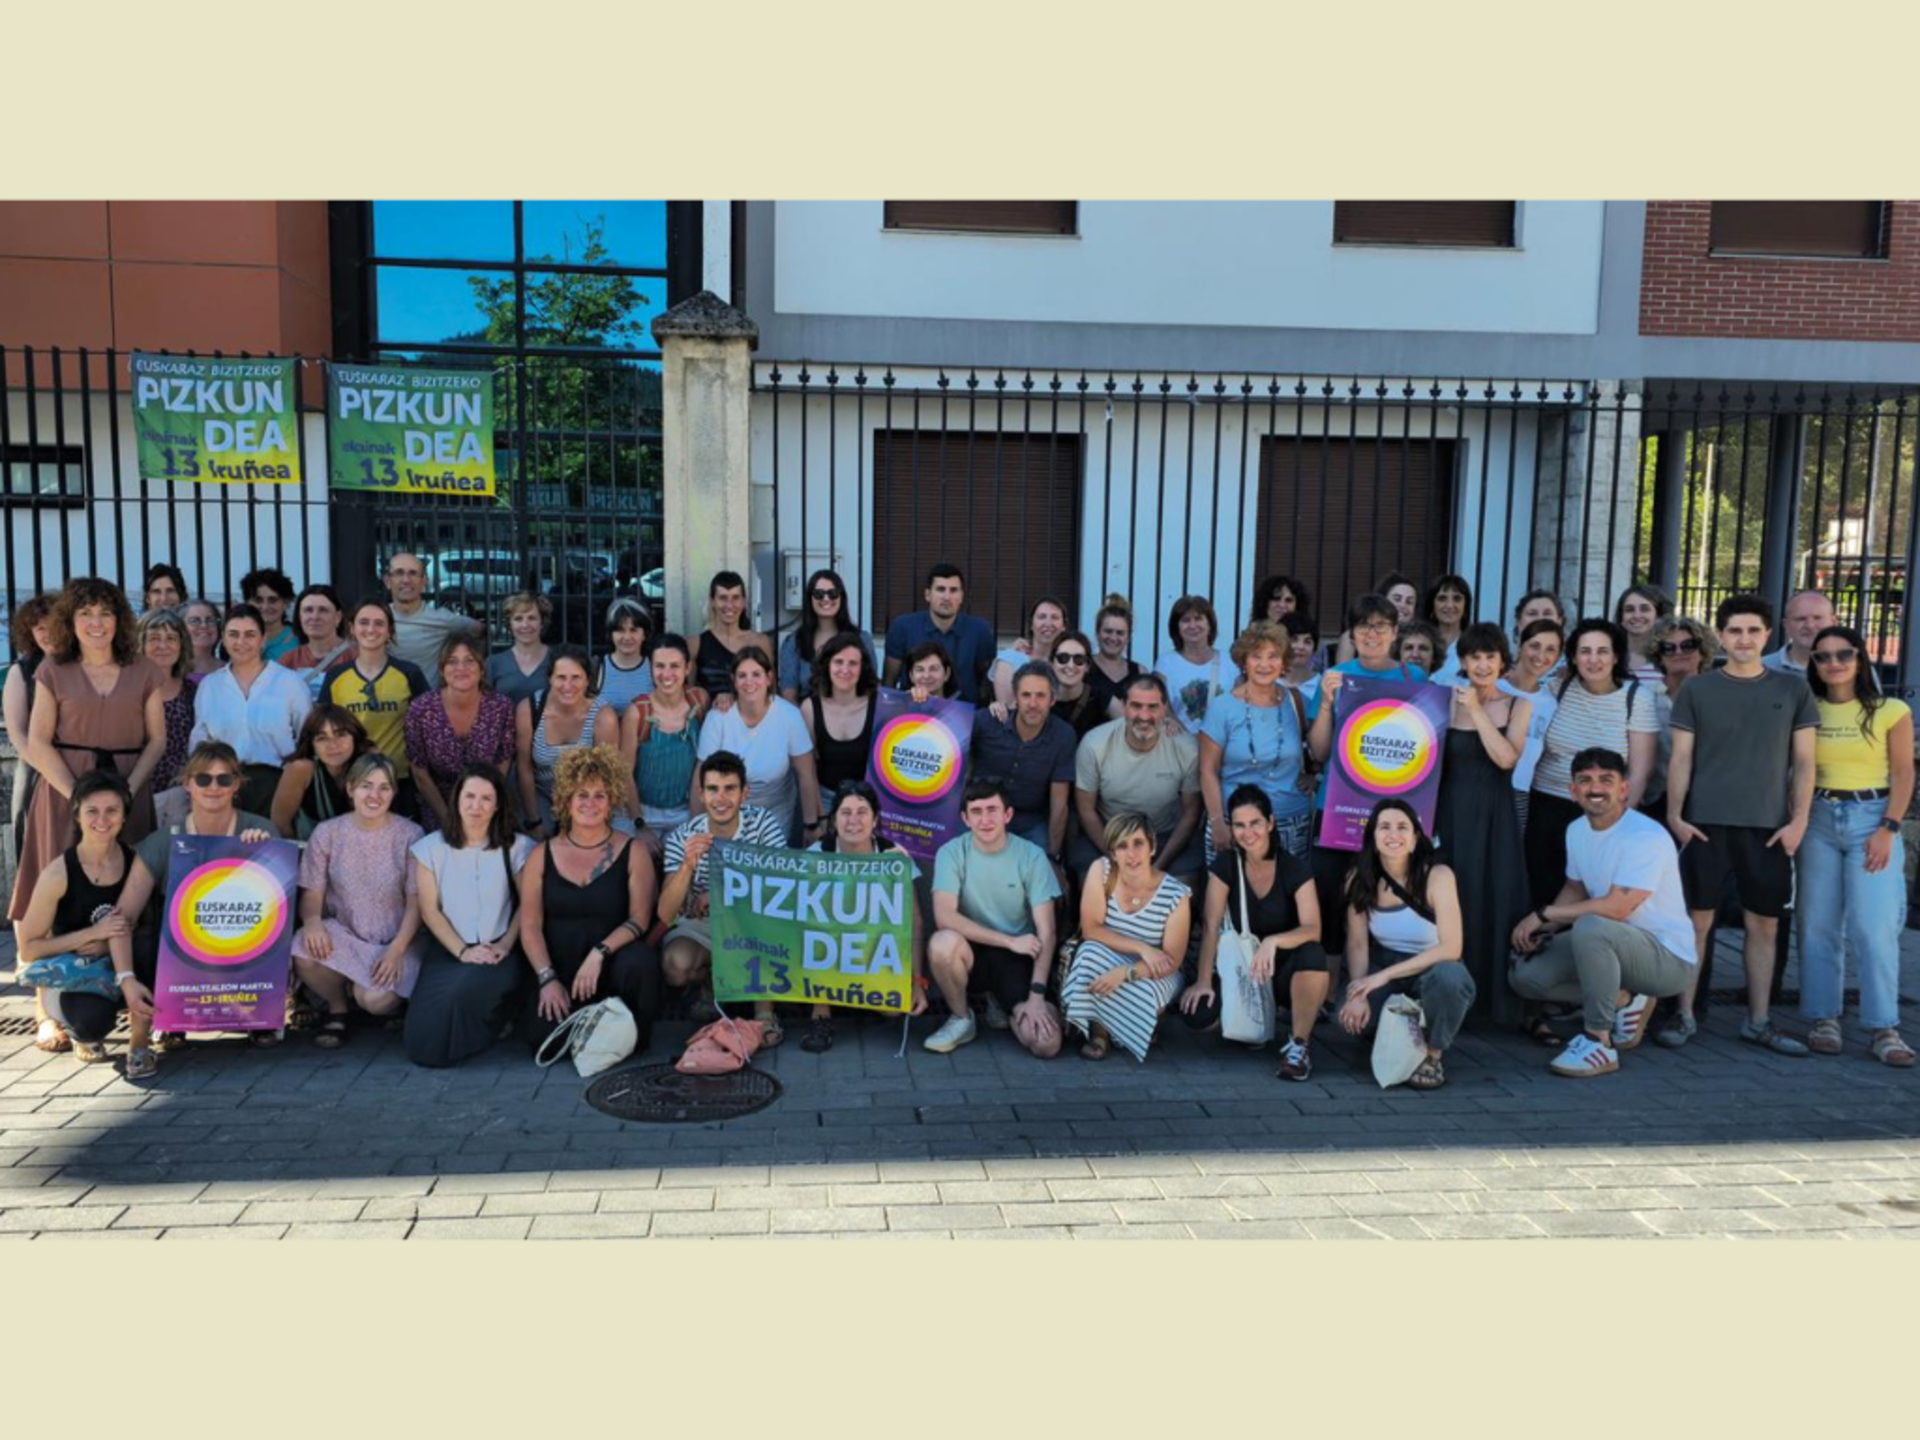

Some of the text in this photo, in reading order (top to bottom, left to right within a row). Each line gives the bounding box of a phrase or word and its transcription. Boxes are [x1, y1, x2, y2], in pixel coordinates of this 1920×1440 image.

[136, 360, 282, 376] EUSKARAZ BIZITZEKO
[338, 370, 481, 388] EUSKARAZ BIZITZEKO
[138, 376, 284, 414] PIZKUN
[339, 387, 482, 426] PIZKUN
[204, 419, 289, 453] DEA
[404, 430, 485, 465] DEA
[161, 447, 200, 477] 13
[207, 458, 291, 480] Iruñea
[359, 458, 400, 487] 13
[406, 468, 487, 491] Iruñea
[892, 746, 942, 763] EUSKARAZ
[1359, 746, 1415, 761] BIZITZEKO
[1361, 735, 1416, 750] EUSKARAZ
[890, 755, 940, 773] BIZITZEKO
[722, 848, 905, 876] EUSKARAZ BIZITZEKO
[195, 902, 262, 912] EUSKARAZ
[723, 867, 904, 925] PIZKUN
[194, 914, 262, 925] BIZITZEKO
[722, 935, 790, 960] ekainak
[802, 929, 903, 975] DEA
[743, 956, 793, 994] 13
[803, 977, 903, 1008] Iruñea
